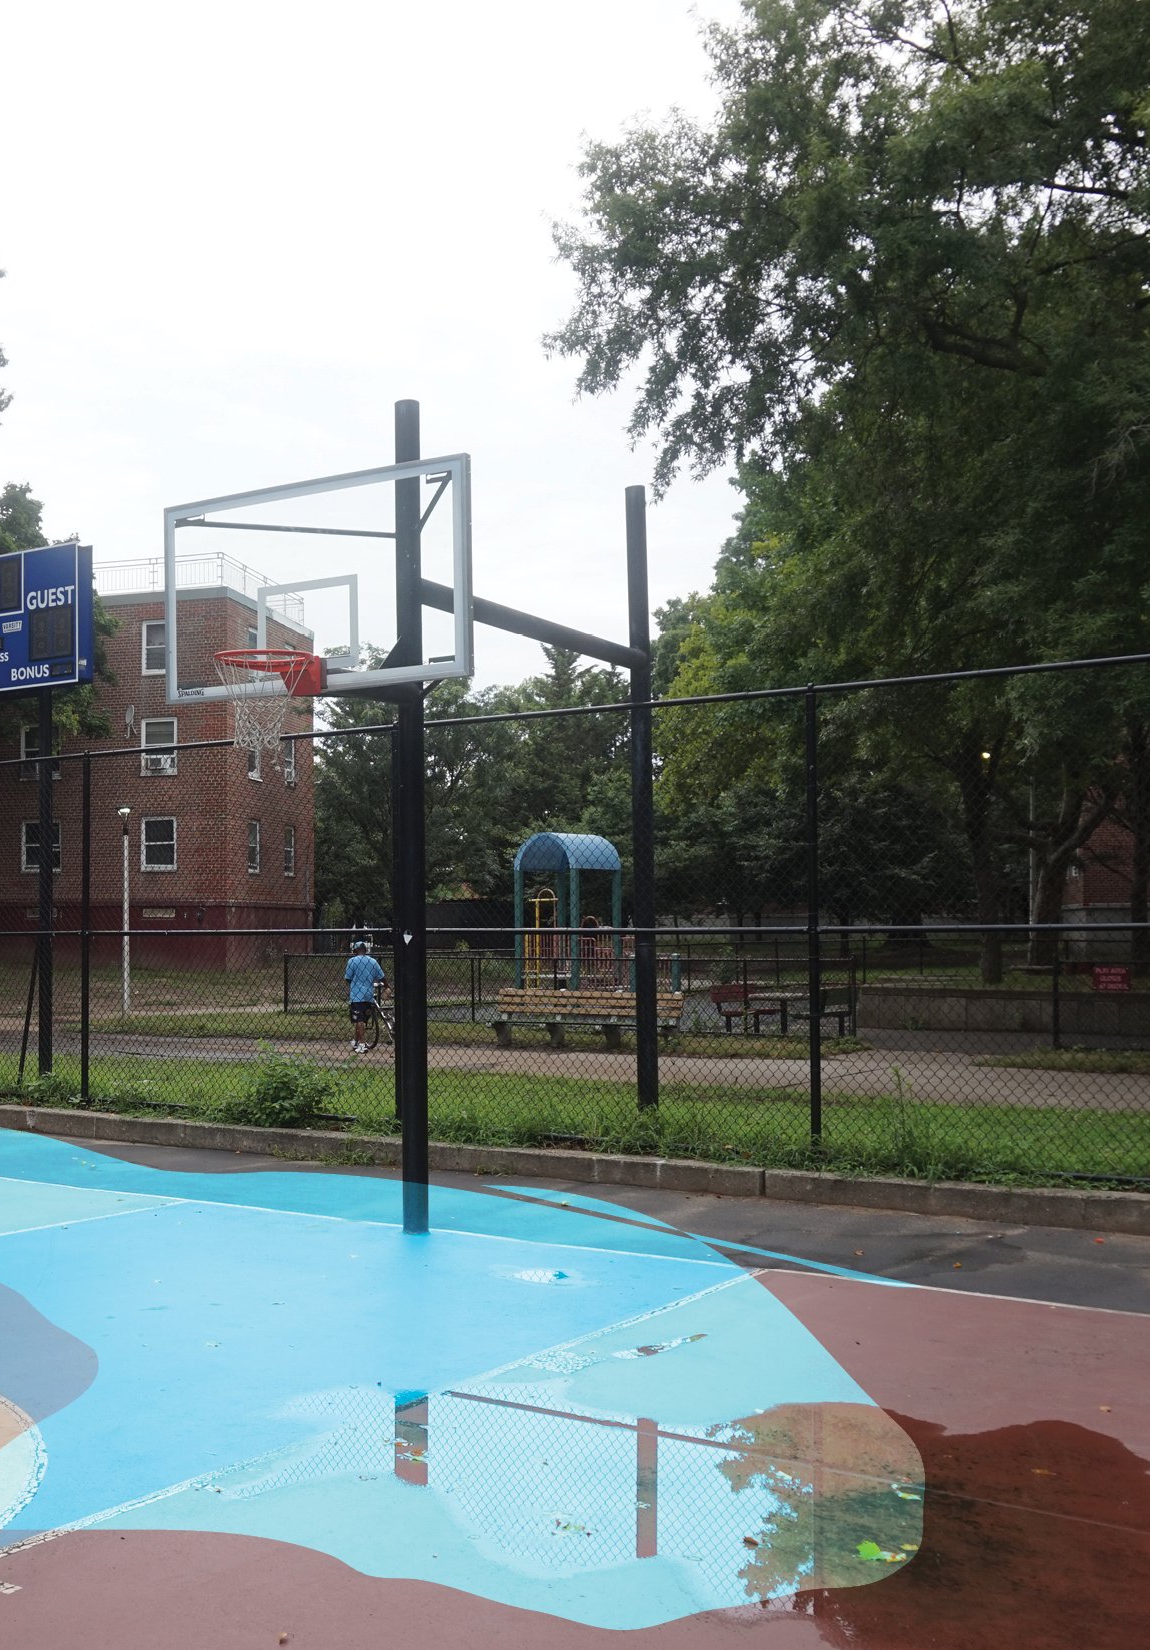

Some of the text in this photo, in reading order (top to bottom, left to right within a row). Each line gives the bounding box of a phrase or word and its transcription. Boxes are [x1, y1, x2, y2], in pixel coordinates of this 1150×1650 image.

[26, 585, 75, 609] GUEST
[11, 664, 50, 681] BONUS
[178, 690, 204, 698] SPALDING
